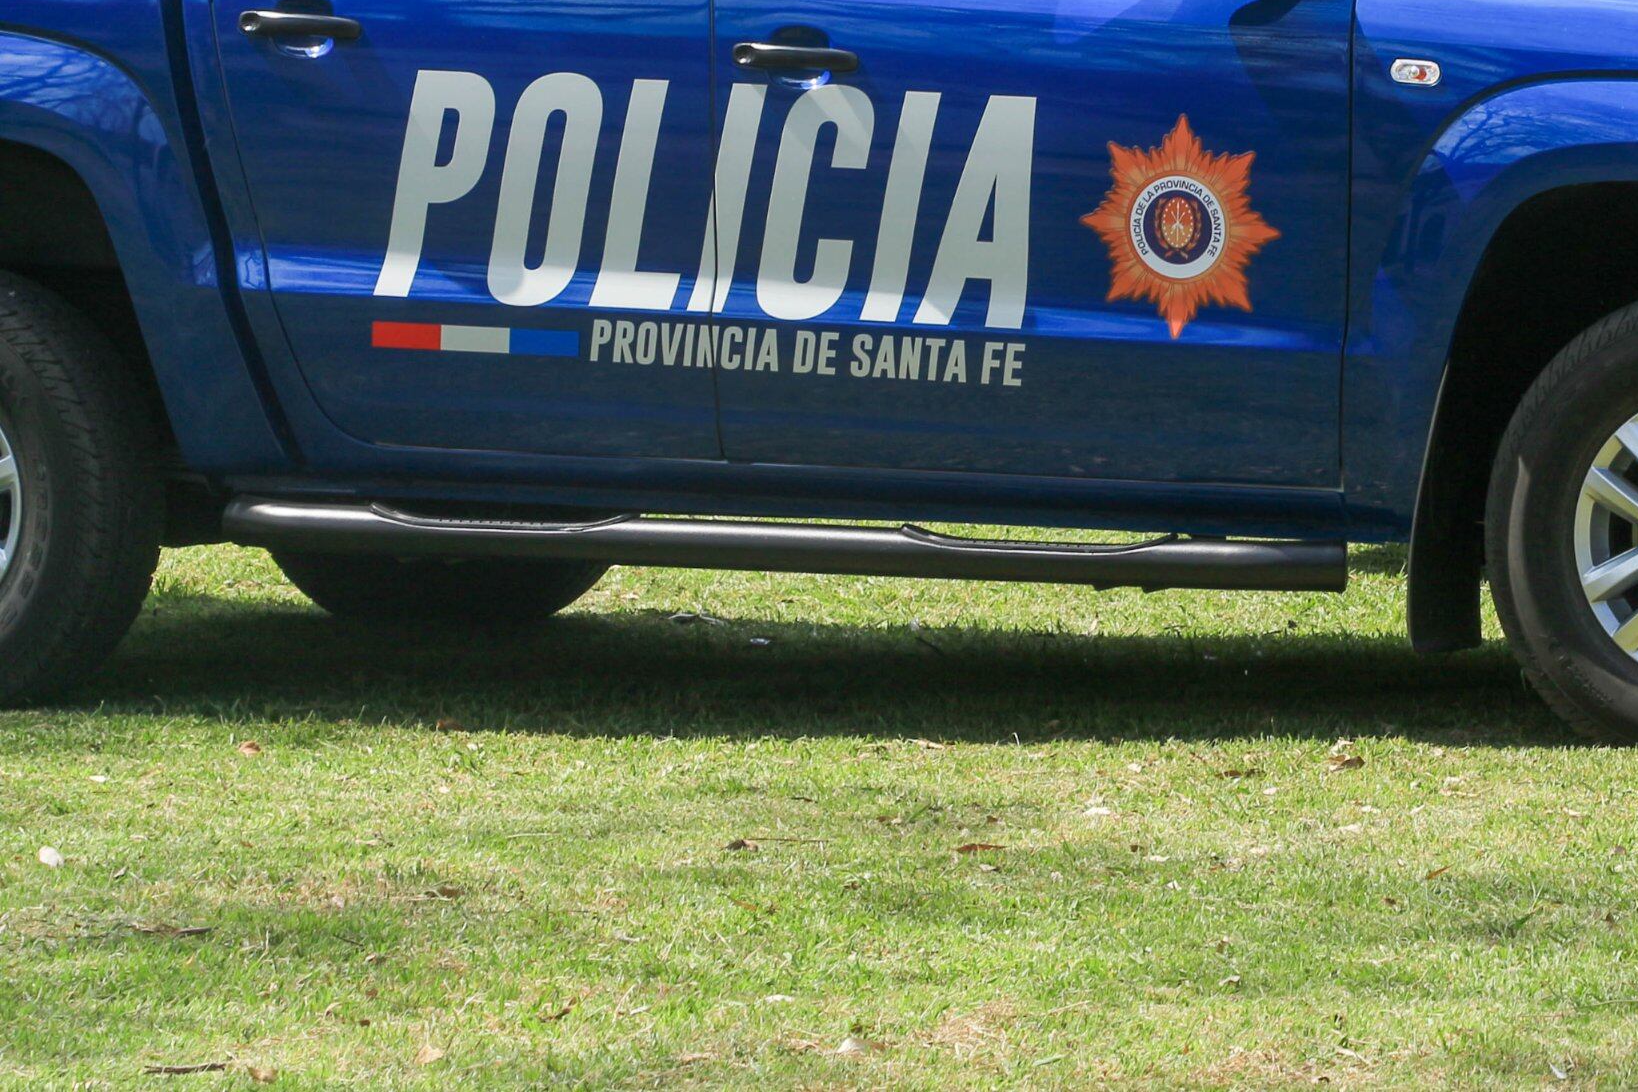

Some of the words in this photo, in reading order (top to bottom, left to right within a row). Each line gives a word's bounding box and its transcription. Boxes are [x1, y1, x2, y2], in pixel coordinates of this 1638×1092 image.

[373, 69, 1036, 329] POLICIA
[1135, 202, 1147, 216] DE
[1142, 190, 1155, 203] LA
[1153, 180, 1203, 197] PROVINCIA
[1202, 194, 1216, 209] DE
[1210, 208, 1222, 243] SANTA
[590, 319, 780, 373] PROVINCIA
[793, 331, 838, 375] DE
[851, 336, 967, 383] SANTA
[980, 341, 1026, 387] FE
